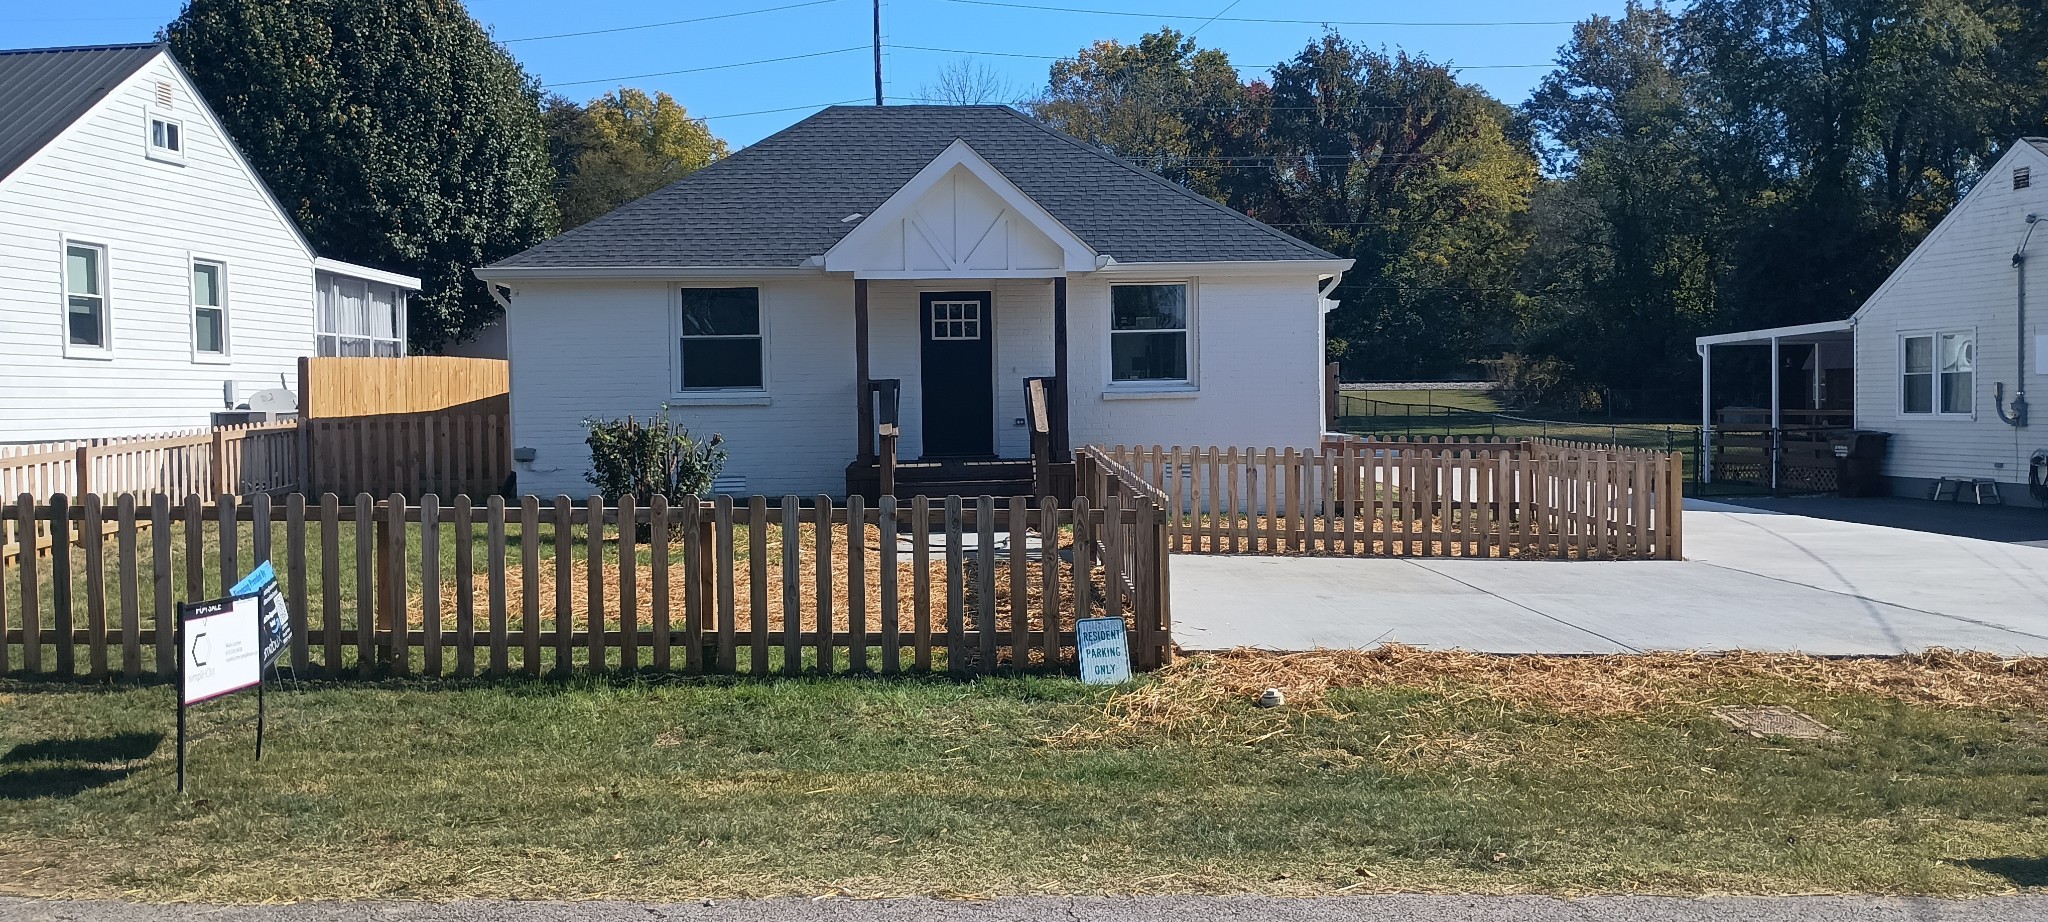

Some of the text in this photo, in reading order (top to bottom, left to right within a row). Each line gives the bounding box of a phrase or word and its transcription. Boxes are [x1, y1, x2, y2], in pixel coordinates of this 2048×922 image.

[1083, 630, 1120, 641] RESIDENT
[1086, 647, 1120, 658] PARKING
[1095, 664, 1115, 675] ONLY
